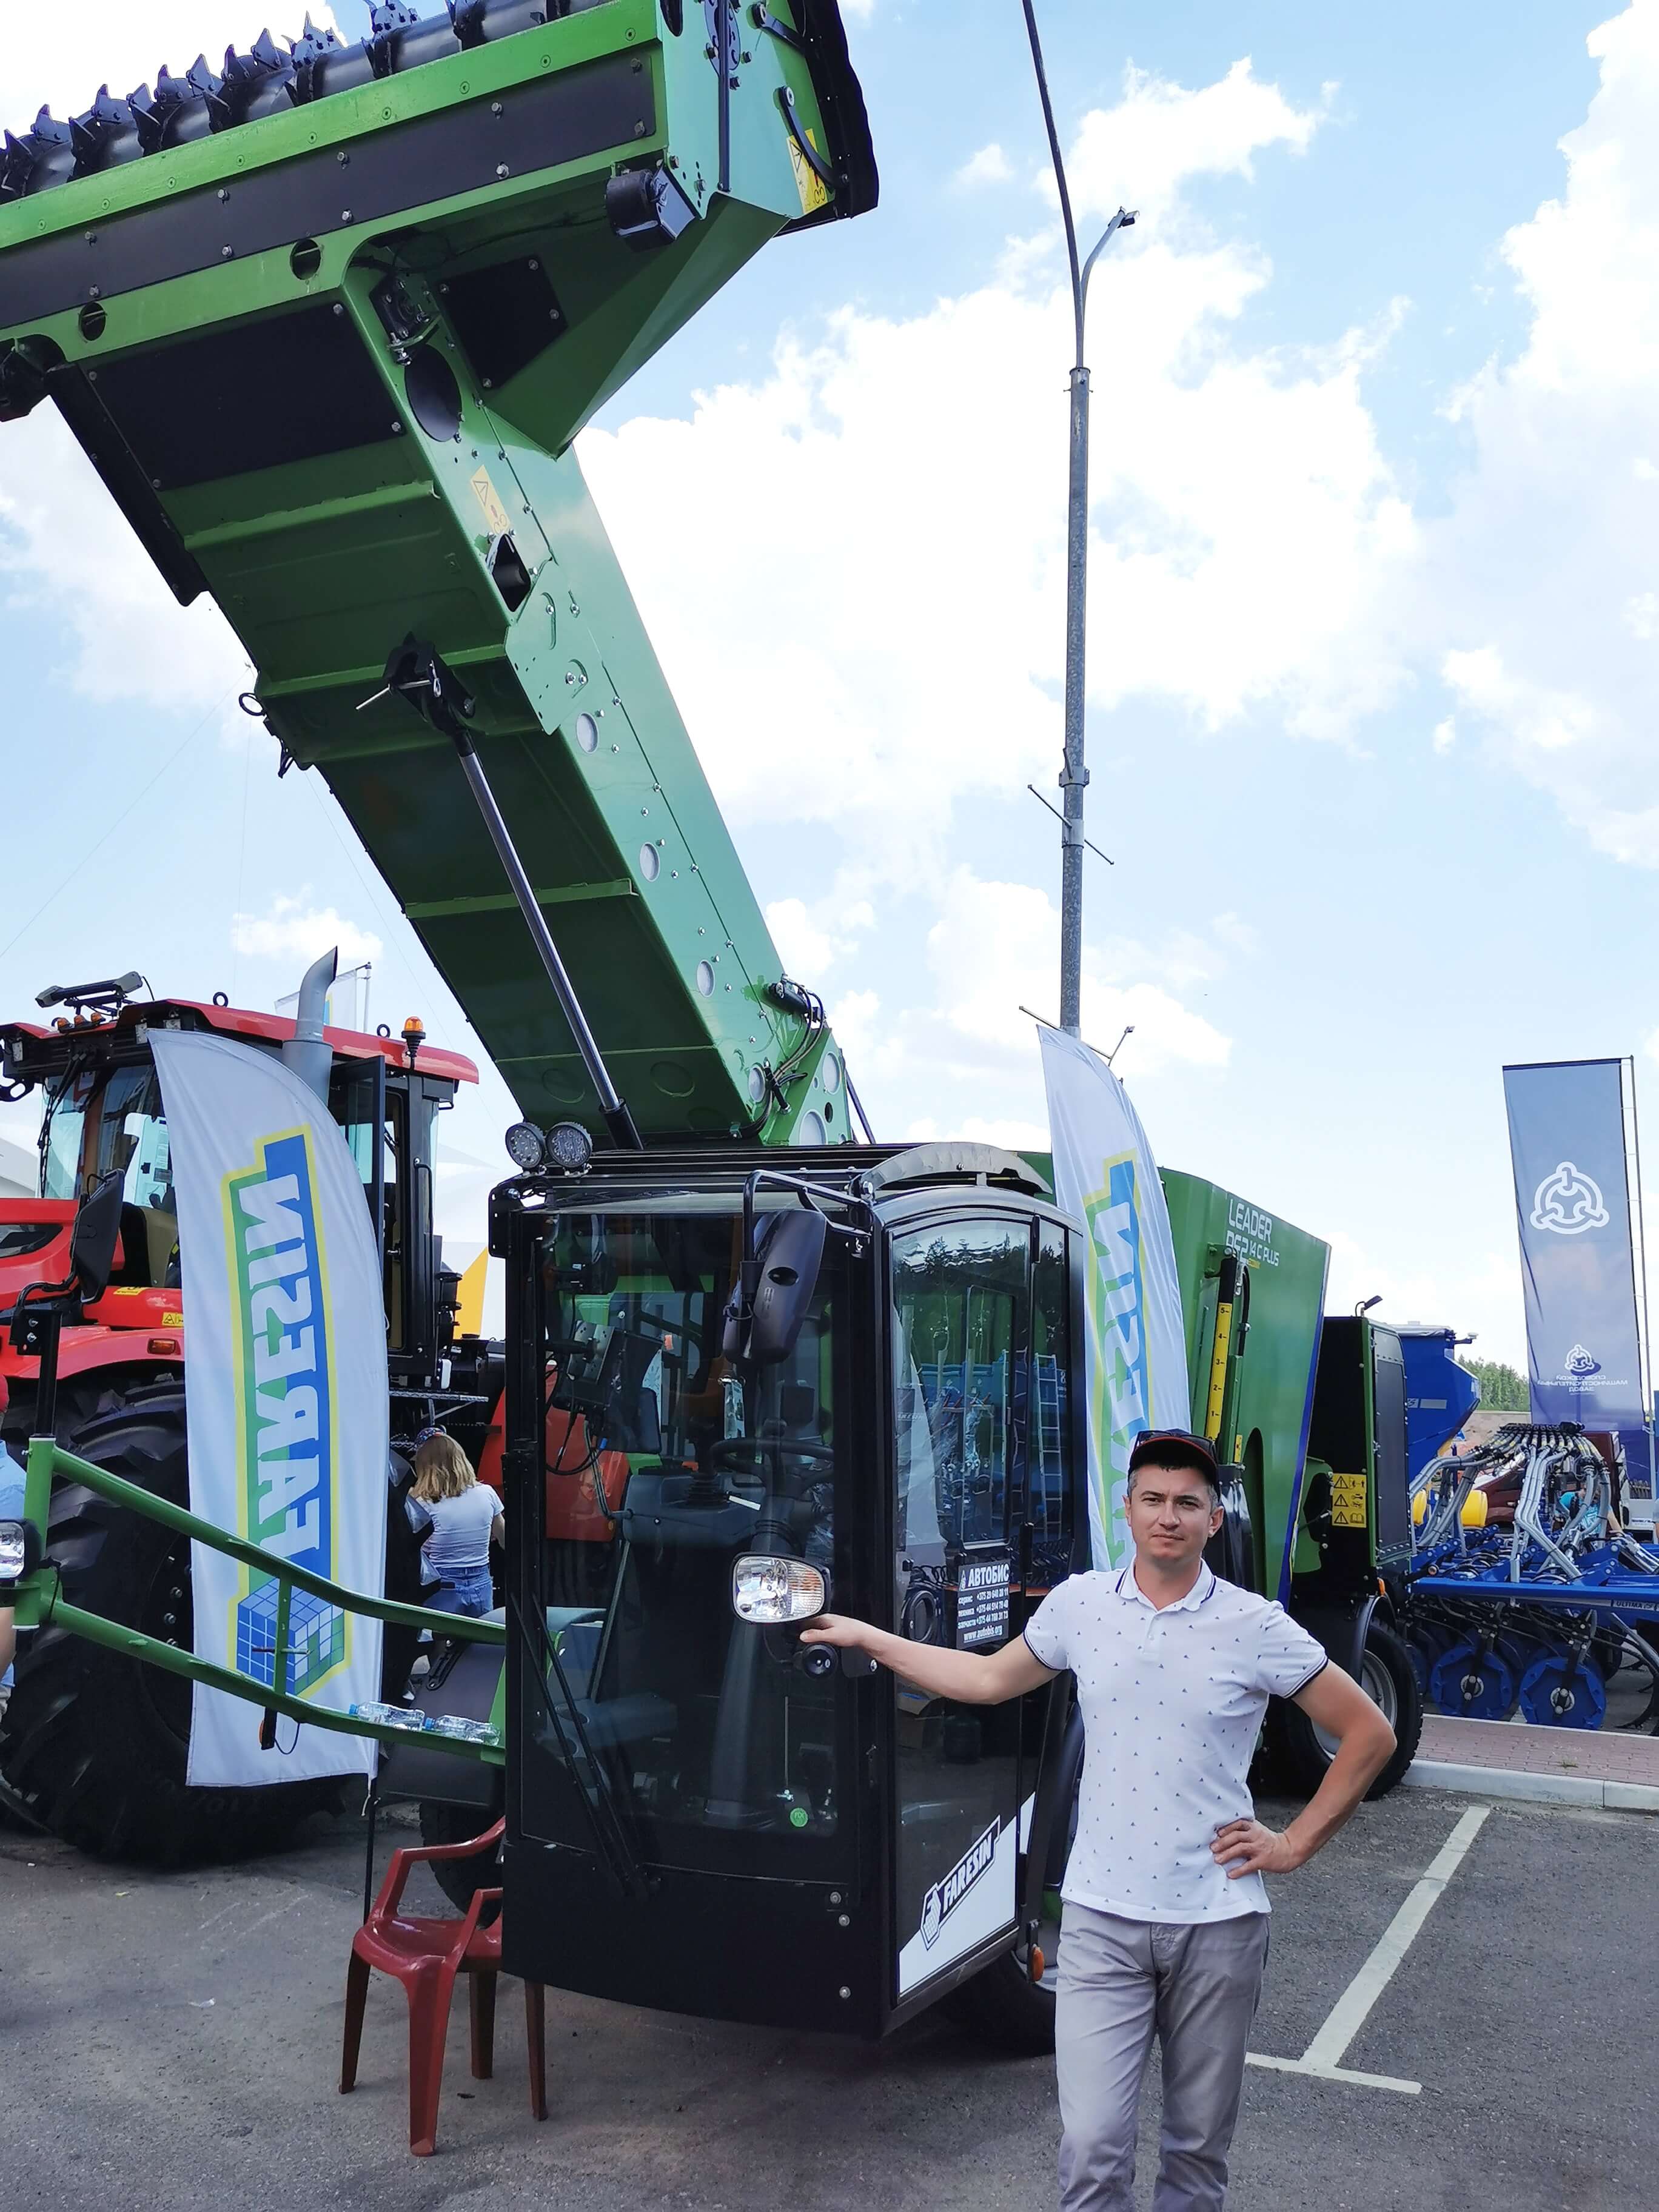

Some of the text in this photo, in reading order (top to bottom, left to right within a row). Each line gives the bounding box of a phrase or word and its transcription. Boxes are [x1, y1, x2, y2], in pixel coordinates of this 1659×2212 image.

[1228, 1199, 1272, 1244] LEADER
[1256, 1244, 1262, 1259] C
[1263, 1246, 1279, 1267] PLUS
[968, 1563, 1010, 1587] АВТОБИС
[942, 1832, 993, 1914] FARESIN
